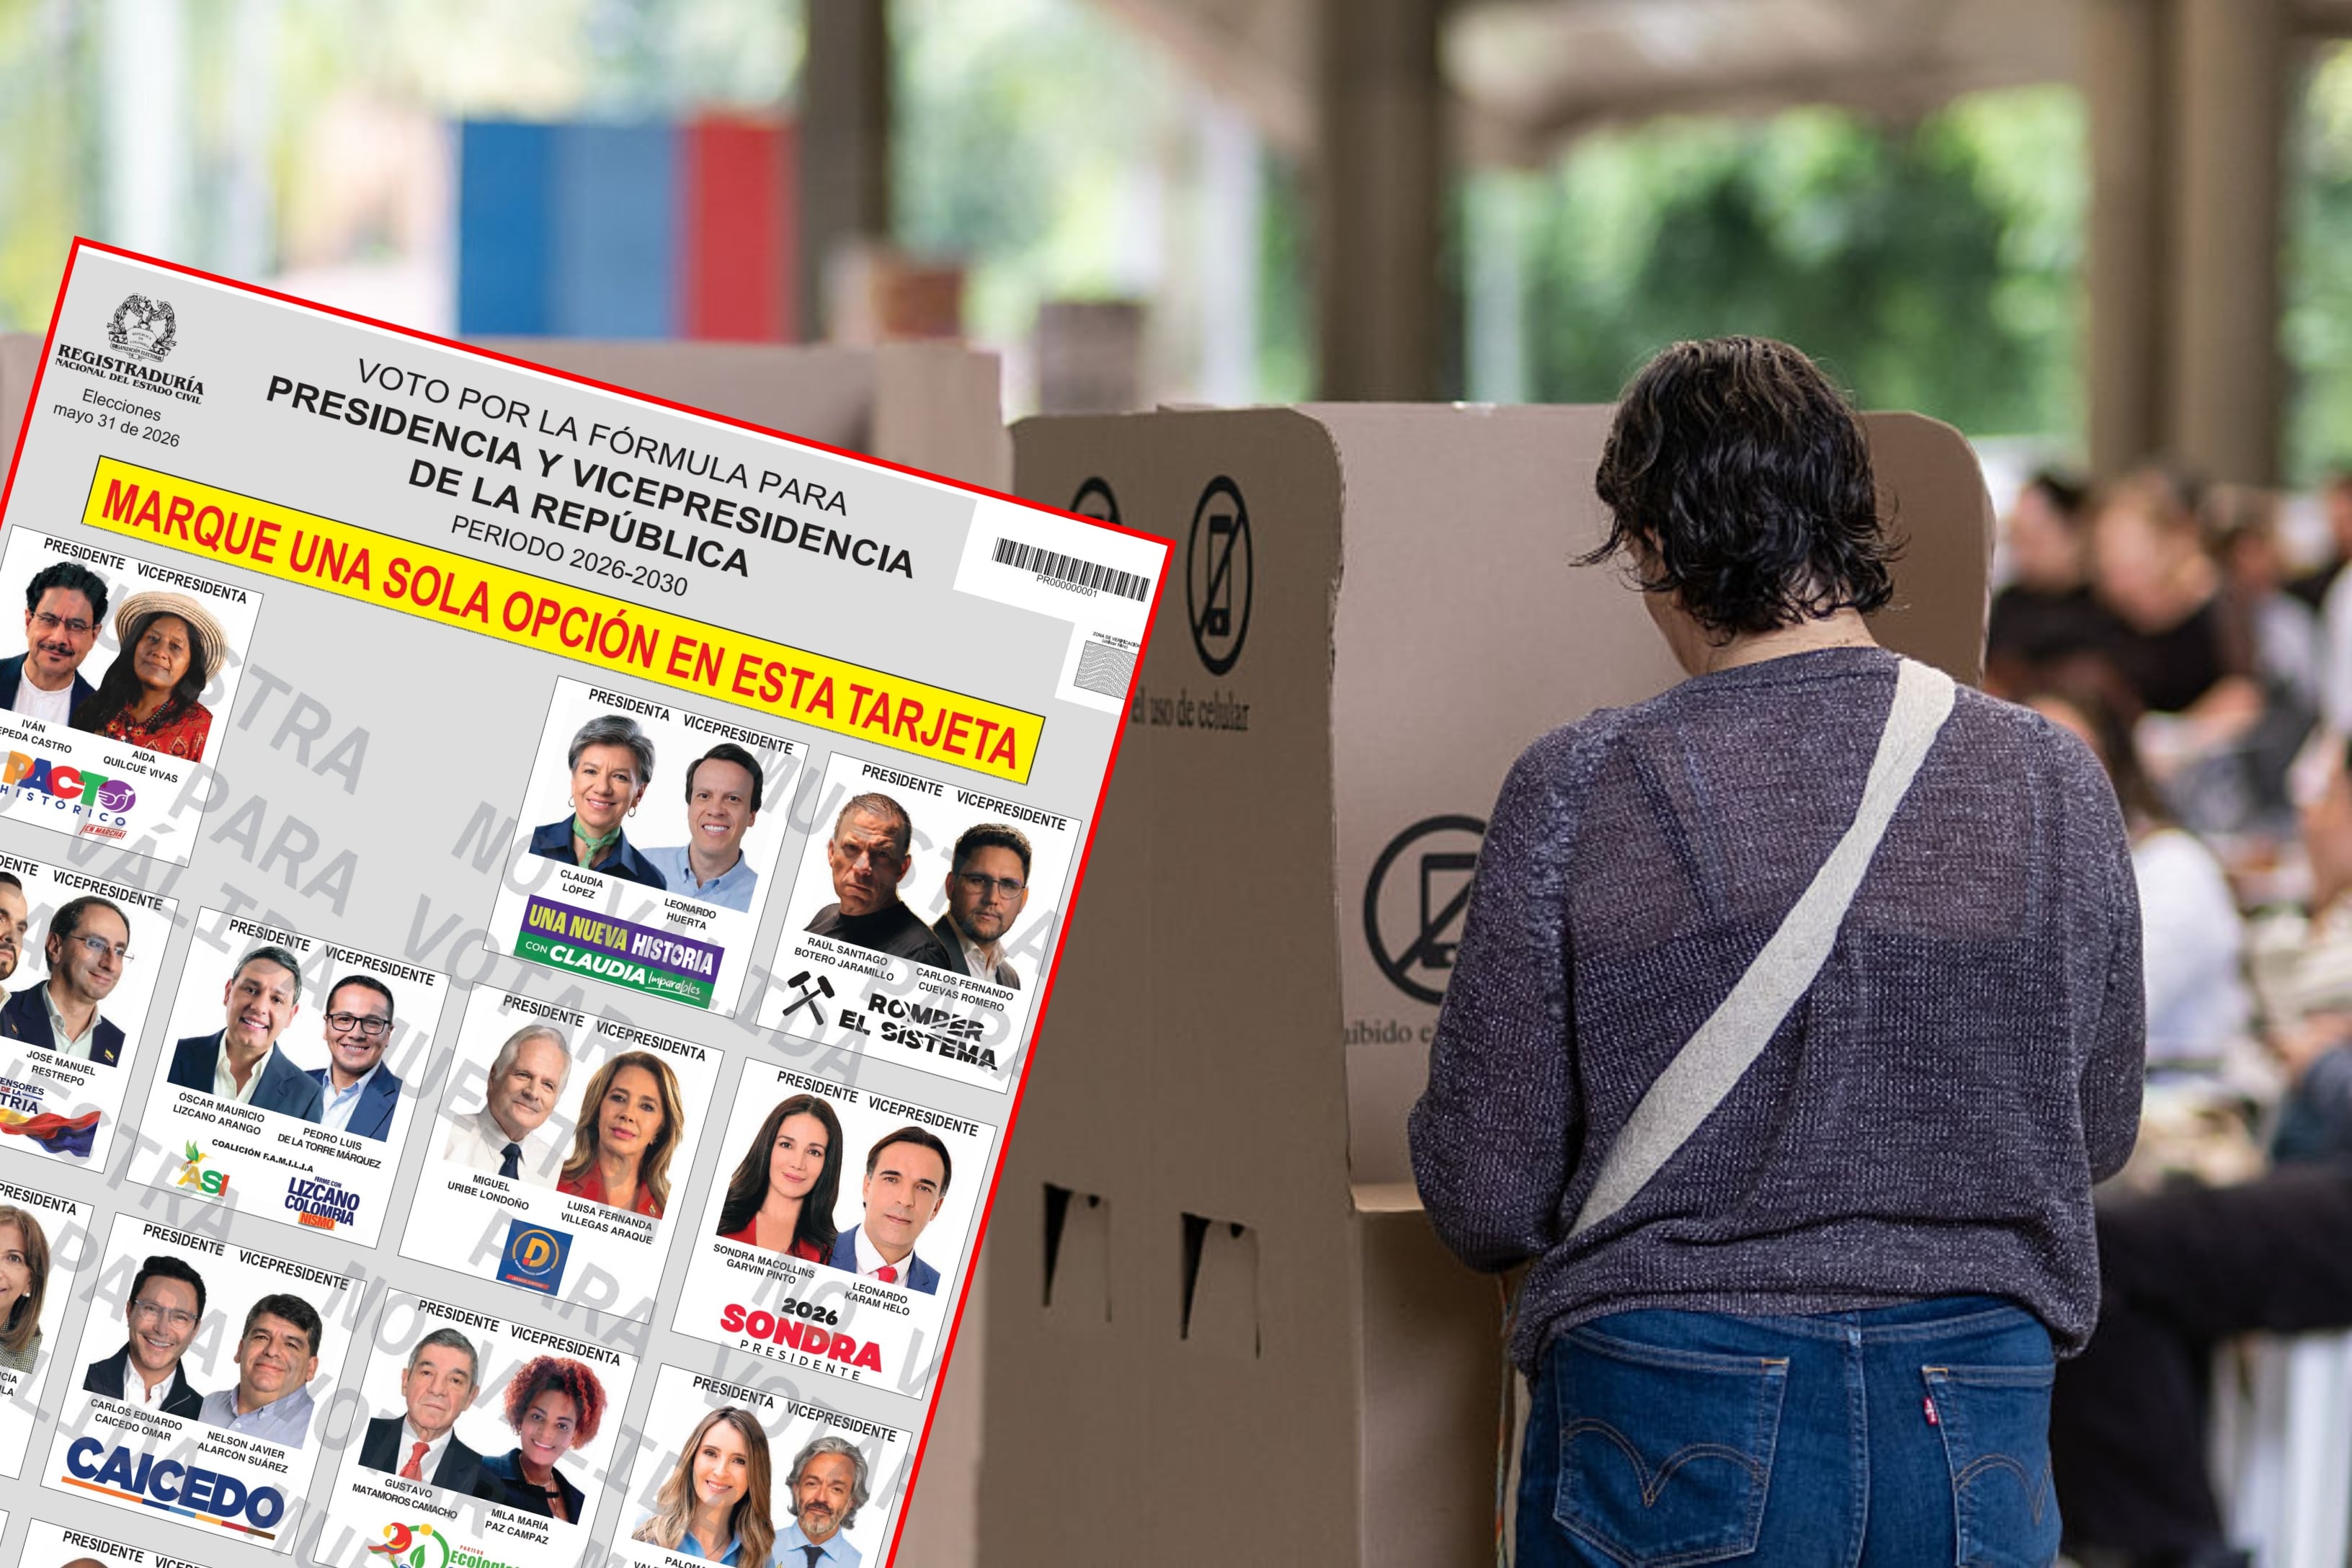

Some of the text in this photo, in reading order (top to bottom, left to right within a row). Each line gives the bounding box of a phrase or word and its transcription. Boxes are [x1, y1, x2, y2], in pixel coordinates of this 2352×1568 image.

[55, 357, 201, 405] NACIONAL DEL ESTADO CIVIL
[58, 344, 204, 396] REGISTRADURÍA
[82, 388, 161, 422] Elecciones
[53, 404, 180, 447] mayo 31 de 2026
[359, 358, 847, 517] VOTO POR LA FÓRMULA PARA
[267, 375, 913, 579] PRESIDENCIA Y VICEPRESIDENCIA
[409, 458, 748, 578] DE LA REPÚBLICA
[44, 537, 246, 604] PRESIDENTE VICEPRESIDENTA
[451, 514, 687, 597] PERIODO 2026-2030
[1036, 574, 1097, 597] PR000000001
[102, 478, 1015, 770] MARQUE UNA SOLA OPCIÓN EN ESTA TARJETA
[589, 688, 794, 755] PRESIDENTA VICEPRESIDENTE
[1176, 687, 1195, 727] de
[22, 719, 45, 733] IVÁN
[31, 736, 72, 754] CASTRO
[132, 750, 155, 764] AÍDA
[2, 750, 136, 814] PACTO
[103, 756, 178, 783] QUILCUÉ VIVAS
[1, 785, 126, 827] HISTÓRICO
[862, 764, 1067, 831] PRESIDENTE VICEPRESIDENTE
[54, 870, 164, 911] VICEPRESIDENTE
[561, 869, 603, 888] CLAUDIA
[562, 883, 595, 899] LÓPEZ
[664, 898, 716, 919] LEONARDO
[667, 912, 706, 930] HUERTA
[229, 919, 435, 986] PRESIDENTE VICEPRESIDENTE
[529, 904, 713, 976] UNA NUEVA HISTORIA
[808, 937, 888, 966] RAÚL SANTIAGO
[525, 941, 548, 954] CON
[549, 945, 646, 985] CLAUDIA
[794, 947, 894, 981] BOTERO JARAMILLO
[916, 967, 1014, 1001] CARLOS FERNANDO
[919, 981, 1004, 1012] CUEVAS ROMERO
[503, 994, 705, 1061] PRESIDENTE VICEPRESIDENTA
[868, 993, 984, 1042] ROMPER
[838, 1009, 998, 1071] EL SISTEMA
[26, 1051, 95, 1076] JOSÉ MANUEL
[31, 1065, 84, 1086] RESTREPO
[173, 1104, 261, 1135] LIZCANO ARANGO
[179, 1092, 264, 1123] ÓSCAR MAURICIO
[777, 1071, 979, 1137] PRESIDENTE VICEPRESIDENTE
[212, 1139, 261, 1158] COALICIÓN
[277, 1133, 381, 1169] DE LA TORRE MÁRQUEZ
[303, 1128, 362, 1151] PEDRO LUIS
[177, 1167, 231, 1197] ASI
[288, 1177, 360, 1211] LIZCANO
[313, 1175, 343, 1190] FIRME CON
[447, 1181, 529, 1210] URIBE LONDOÑO
[473, 1175, 510, 1192] MIGUEL
[285, 1195, 354, 1226] COLOMBIA
[300, 1211, 335, 1230] NISMO
[567, 1200, 651, 1231] LUISA FERNANDA
[561, 1212, 653, 1244] VILLEGAS ARAQUE
[143, 1224, 349, 1291] PRESIDENTE VICEPRESIDENTE
[713, 1244, 815, 1278] SONDRA MACOLLINS
[726, 1259, 796, 1284] GARVIN PINTO
[845, 1291, 910, 1316] KARAM HELO
[852, 1282, 908, 1304] LEONARDO
[781, 1297, 838, 1326] 2026
[418, 1299, 620, 1366] PRESIDENTE VICEPRESIDENTA
[720, 1304, 882, 1373] SONDRA
[740, 1340, 860, 1381] PRESIDENTE
[91, 1399, 182, 1430] CARLOS EDUARDO
[692, 1376, 897, 1443] PRESIDENTA VICEPRESIDENTE
[95, 1413, 172, 1441] CAICEDO OMAR
[197, 1442, 288, 1474] ALARCÓN SUÁREZ
[207, 1431, 285, 1459] NELSON JAVIER
[66, 1437, 285, 1528] CAICEDO
[385, 1479, 432, 1498] GUSTAVO
[352, 1483, 458, 1519] MATAMOROS CAMACHO
[485, 1520, 549, 1545] PAZ CAMPAZ
[491, 1508, 548, 1531] MILA MARÍA
[63, 1531, 145, 1563] PRESIDENTE
[458, 1544, 485, 1556] PARTIDO
